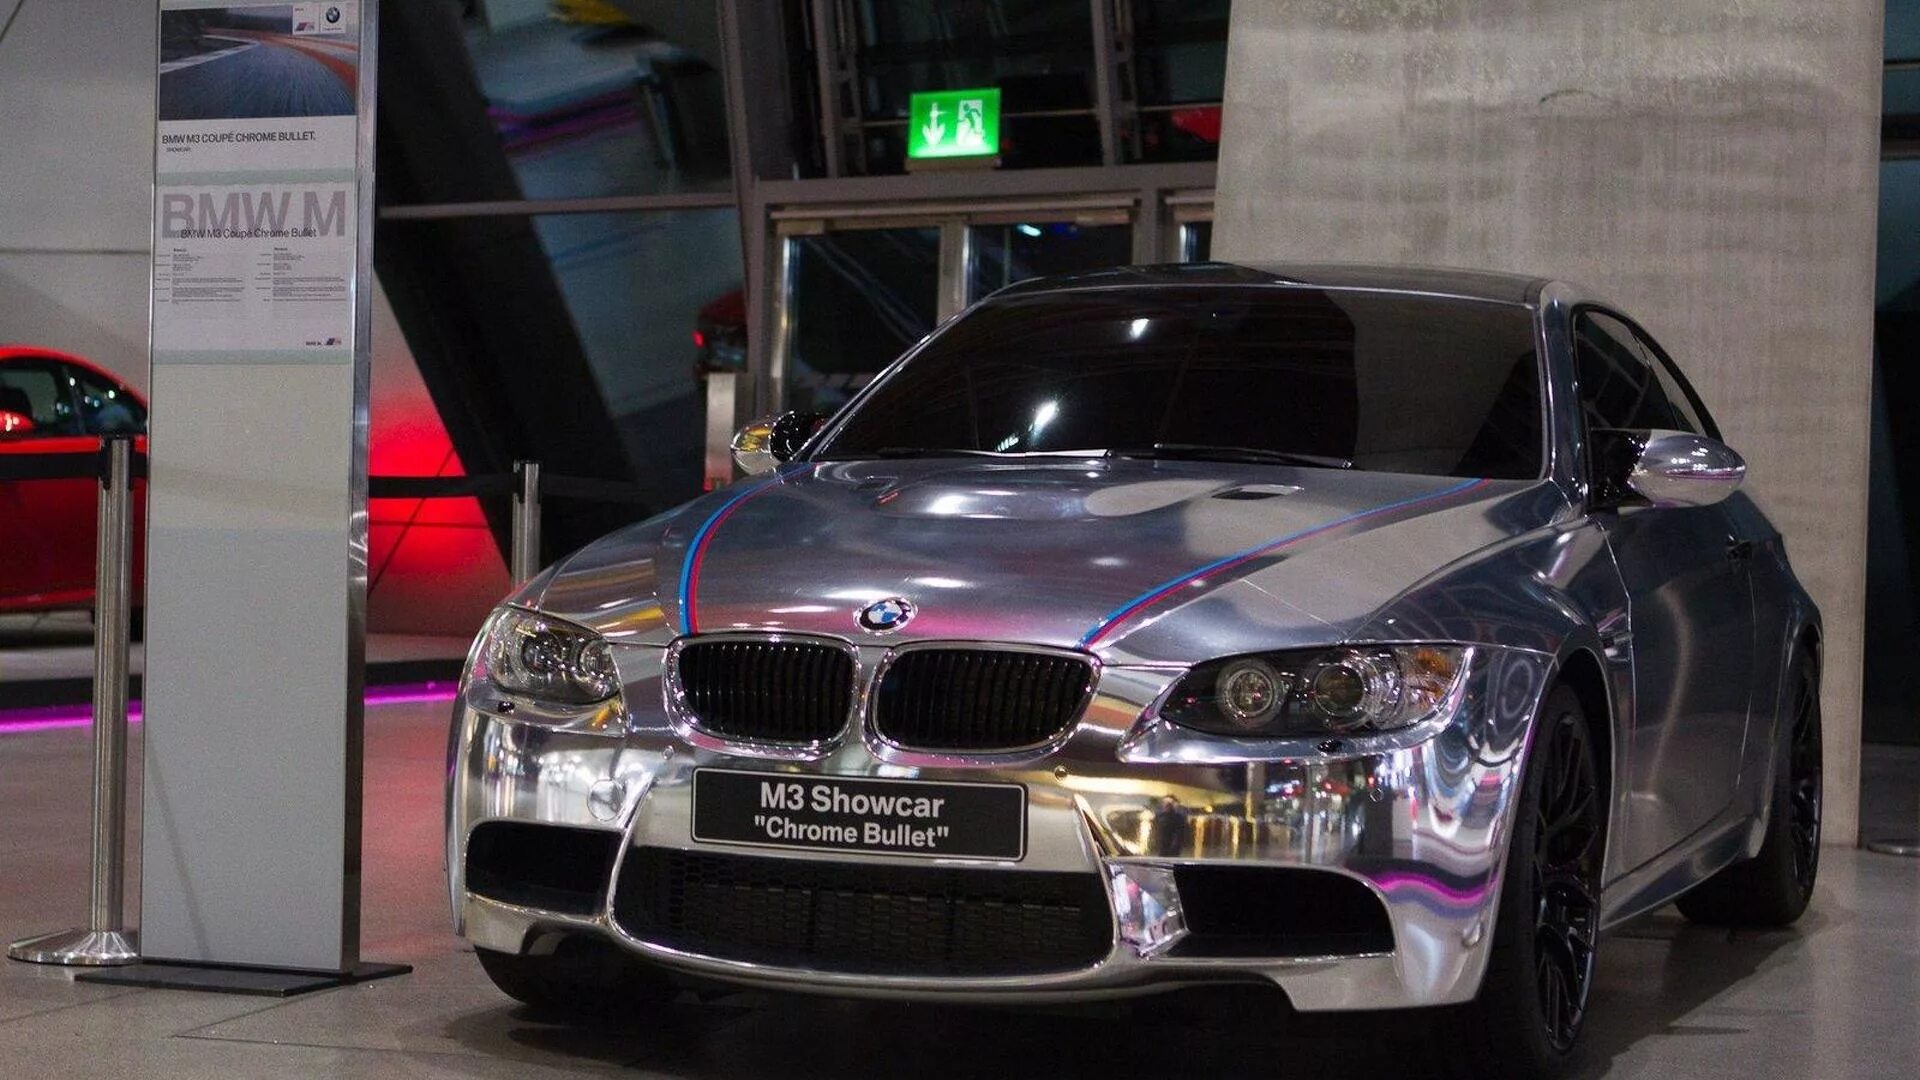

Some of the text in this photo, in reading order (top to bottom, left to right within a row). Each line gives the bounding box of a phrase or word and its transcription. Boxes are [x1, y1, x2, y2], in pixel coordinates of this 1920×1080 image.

[162, 131, 316, 144] BMW M3 COUPÉ CHROME BULLET.
[162, 190, 346, 239] BMW M
[180, 229, 205, 239] BMW
[207, 229, 221, 238] M3
[254, 228, 289, 238] Chrome
[291, 227, 317, 238] Bullet
[760, 781, 945, 818] M3 Showcar
[754, 815, 949, 848] "Chrome Bullet"
